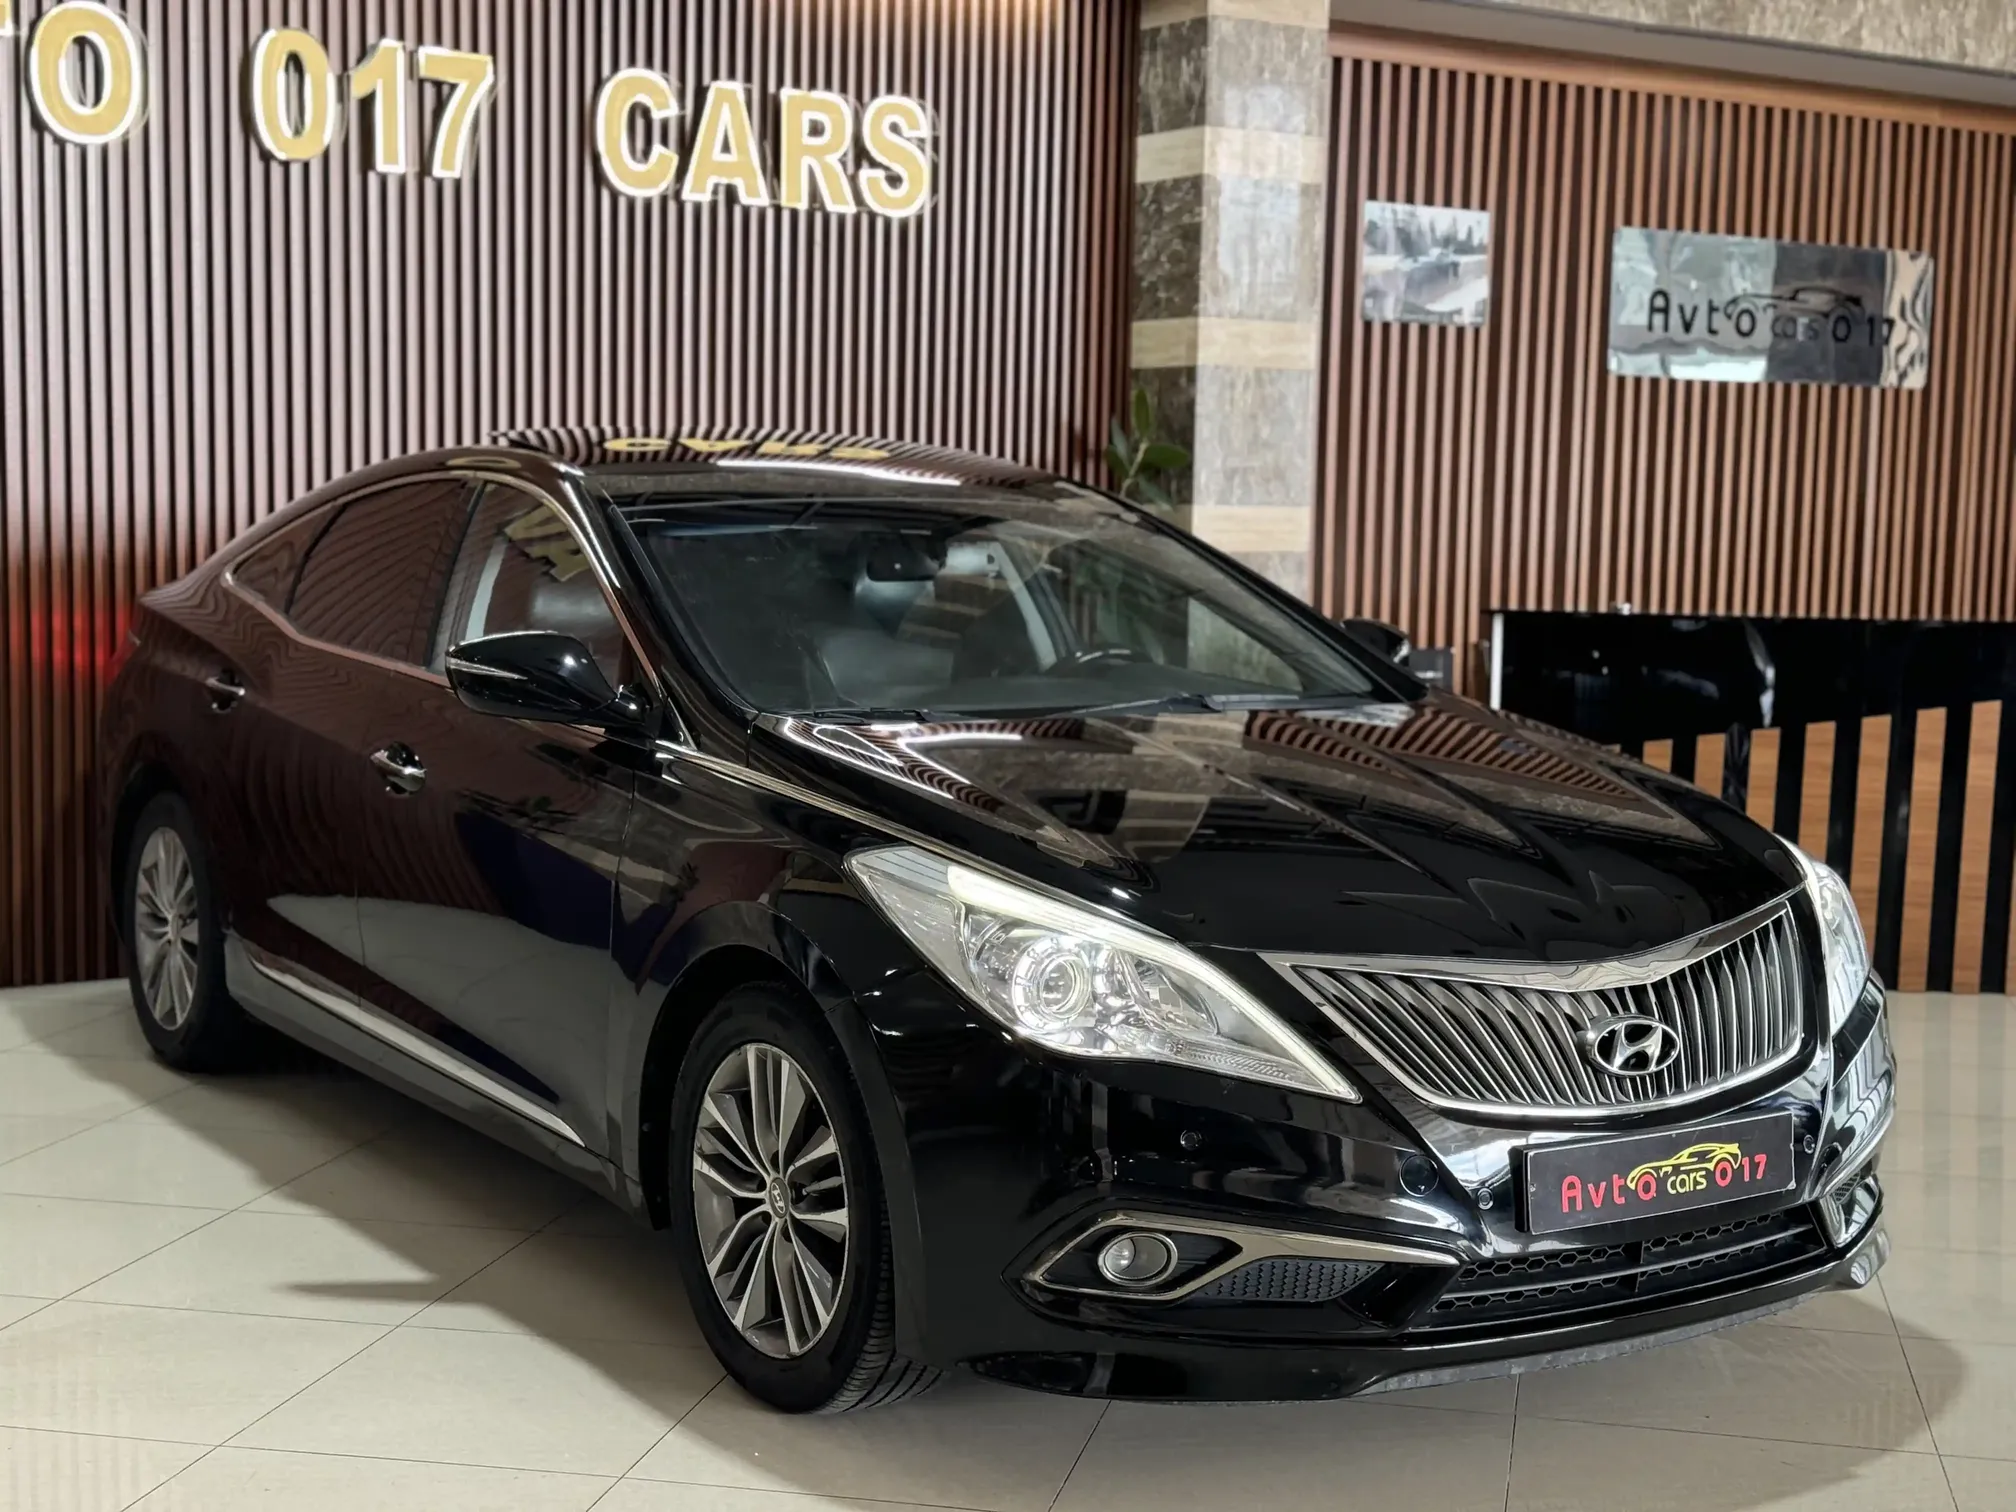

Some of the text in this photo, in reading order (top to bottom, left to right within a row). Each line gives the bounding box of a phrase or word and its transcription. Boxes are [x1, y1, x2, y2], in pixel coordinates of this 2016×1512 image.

[0, 0, 932, 218] O 017 CARS
[1647, 288, 1757, 338] Avto
[1561, 1173, 1657, 1213] Avto
[1666, 1169, 1707, 1195] cars
